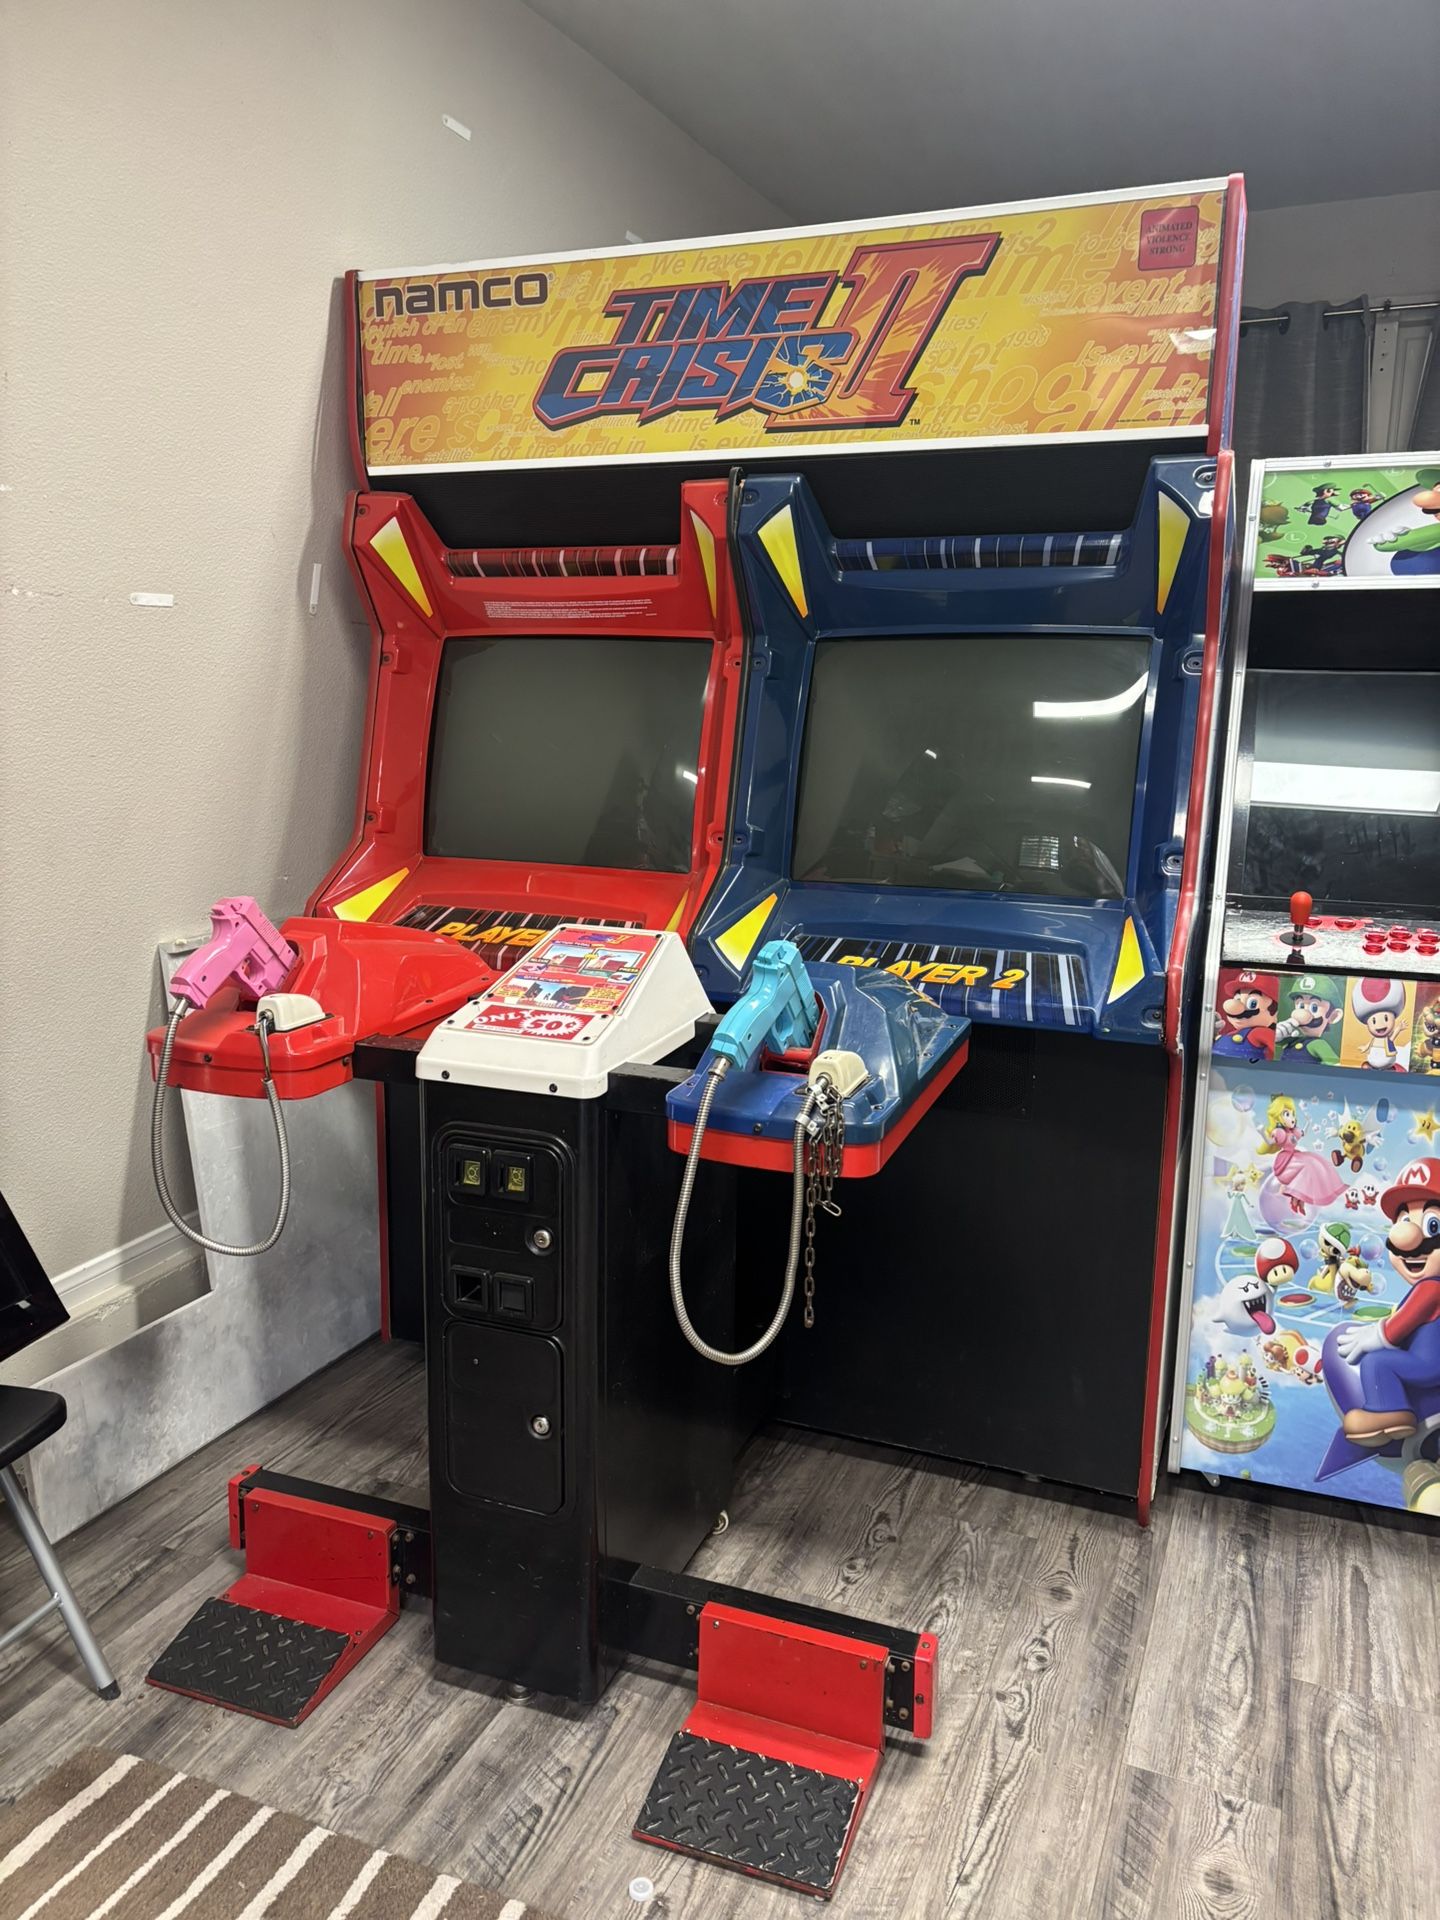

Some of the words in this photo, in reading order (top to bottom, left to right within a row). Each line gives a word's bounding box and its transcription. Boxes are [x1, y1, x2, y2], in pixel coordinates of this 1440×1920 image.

[1145, 221, 1193, 235] ANIMATED
[1146, 233, 1191, 246] VIOLENCE
[1148, 245, 1186, 258] STRONG
[374, 272, 549, 318] namco
[604, 270, 840, 347] TIME
[1003, 325, 1051, 348] 1998
[563, 433, 621, 456] world
[990, 968, 1027, 989] 2
[473, 1010, 535, 1025] ONLY
